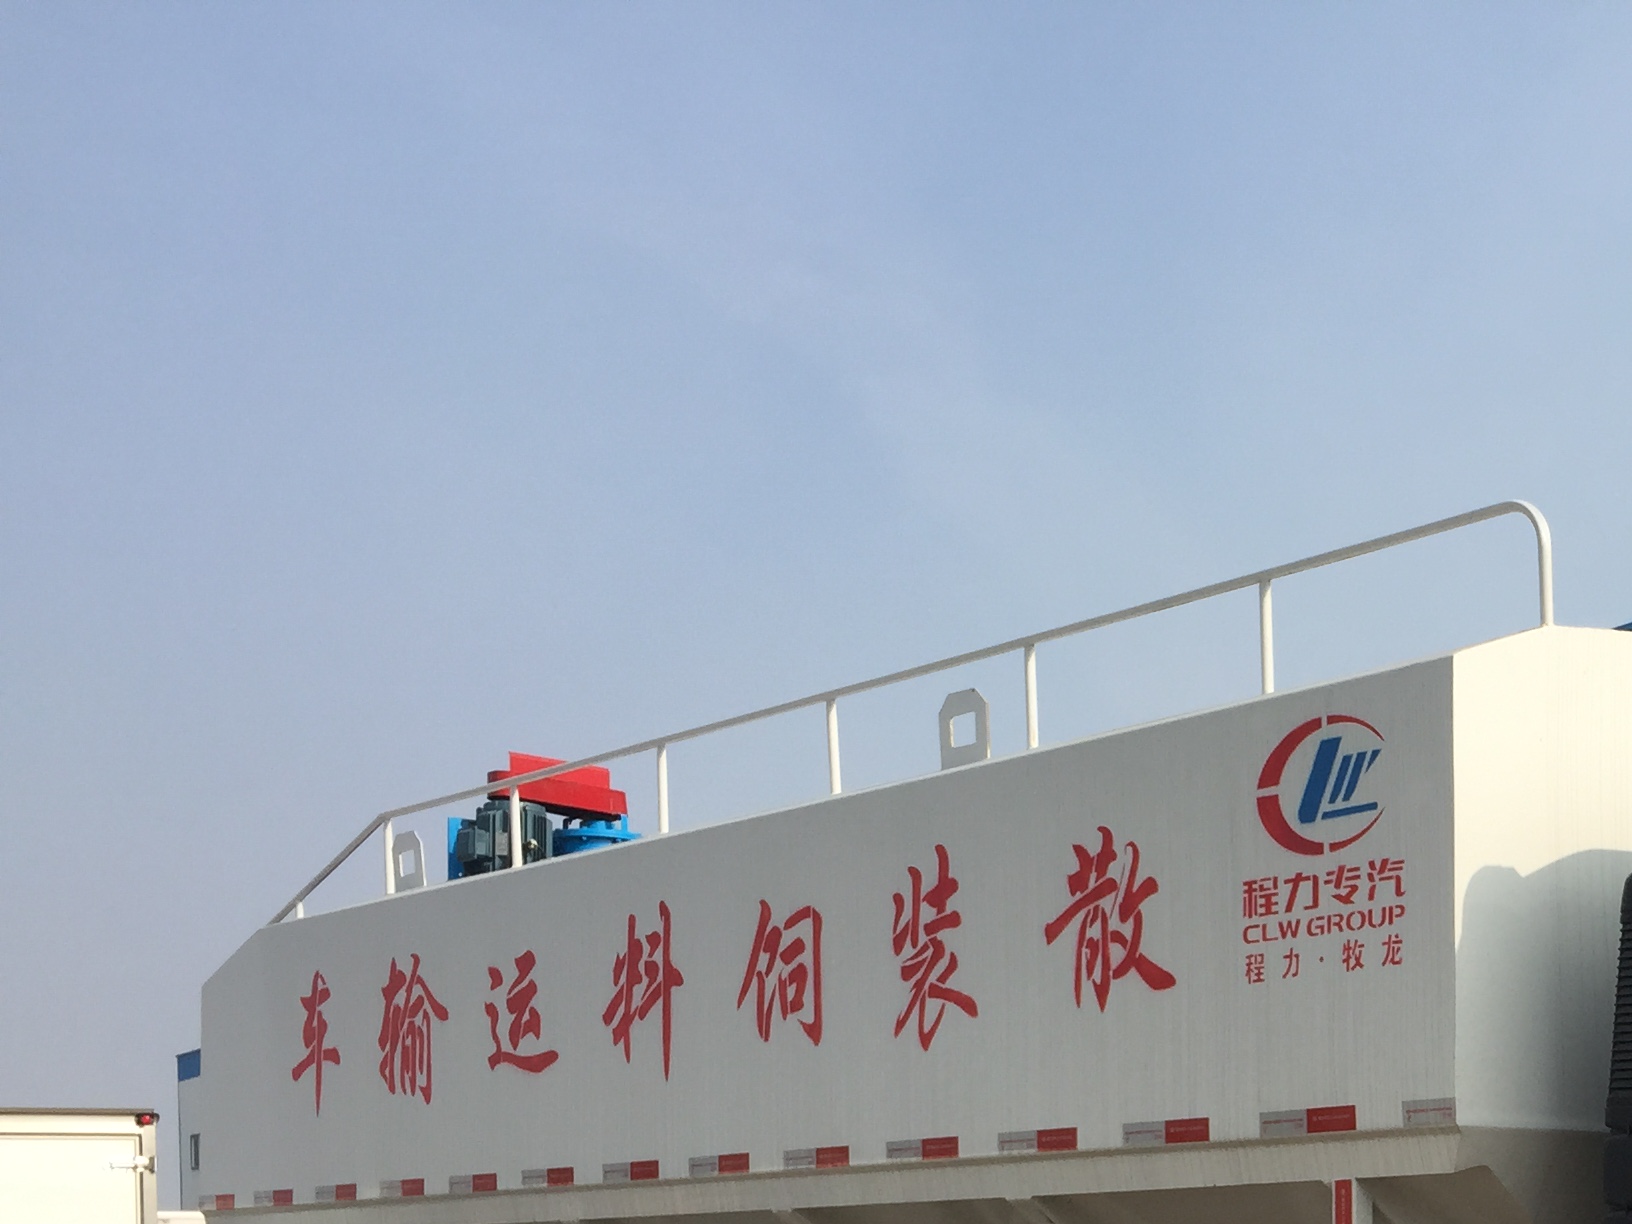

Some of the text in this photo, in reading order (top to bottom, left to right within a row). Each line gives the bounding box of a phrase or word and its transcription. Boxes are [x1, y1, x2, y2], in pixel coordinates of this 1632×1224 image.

[1242, 857, 1407, 919] 程力专汽
[1242, 904, 1406, 945] CLW GROUP
